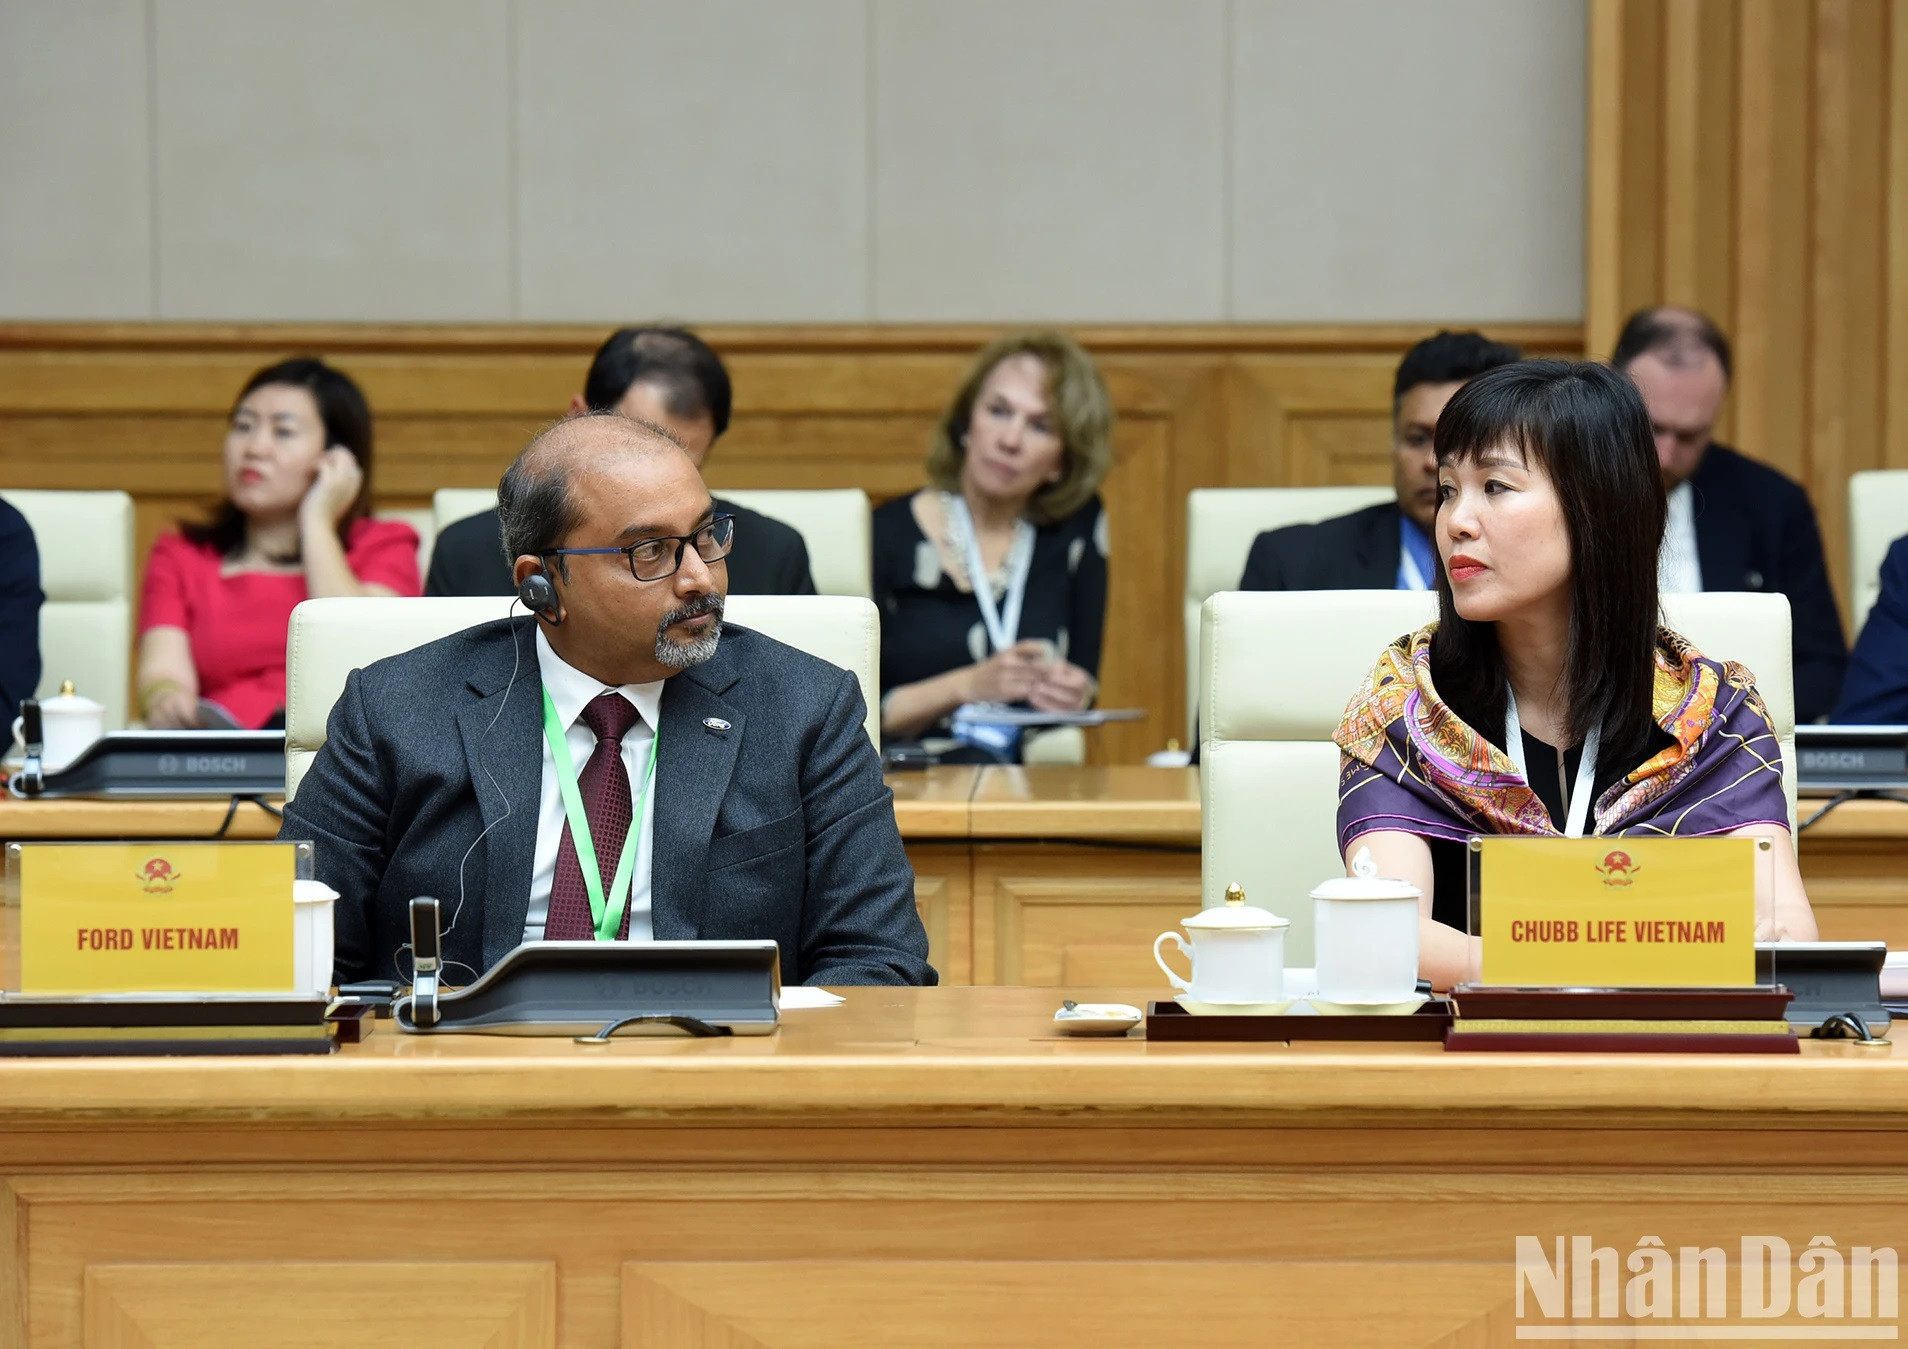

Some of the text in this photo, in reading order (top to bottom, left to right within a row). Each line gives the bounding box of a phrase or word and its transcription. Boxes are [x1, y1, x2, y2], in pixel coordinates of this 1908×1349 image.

[186, 756, 246, 772] BOSCH
[1803, 752, 1864, 769] BOSCH
[78, 928, 239, 950] FORD VIETNAM
[1511, 920, 1725, 943] CHUBB LIFE VIETNAM
